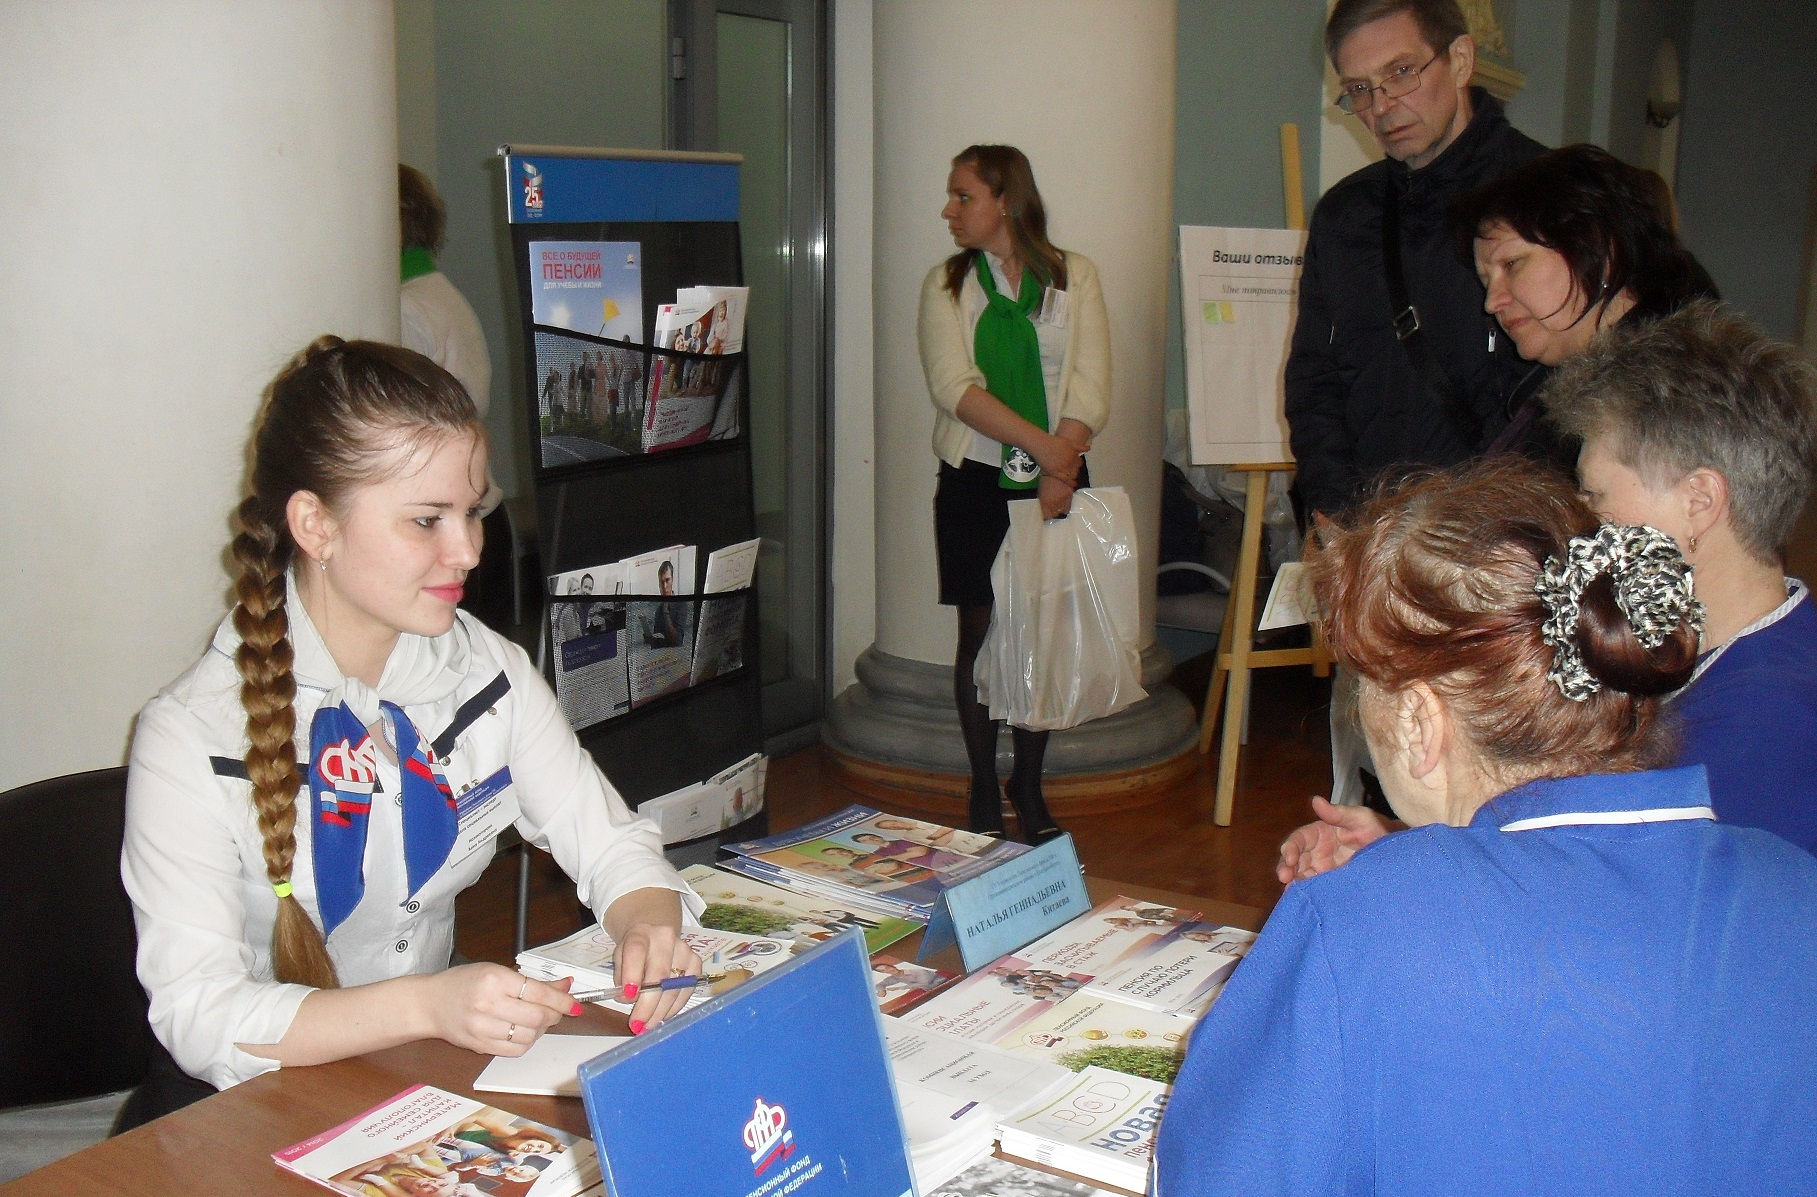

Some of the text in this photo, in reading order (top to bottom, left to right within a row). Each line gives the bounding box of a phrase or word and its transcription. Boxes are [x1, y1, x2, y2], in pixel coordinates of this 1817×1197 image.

[525, 186, 539, 207] 25
[1213, 250, 1251, 264] Ваши
[543, 263, 603, 280] ПЕНСИИ
[967, 880, 1066, 938] НАТАЛЬЯ ГЕННАДЬЕВНА
[790, 1155, 811, 1173] ФОНД
[783, 1162, 823, 1194] ФЕДЕРАЦИИ
